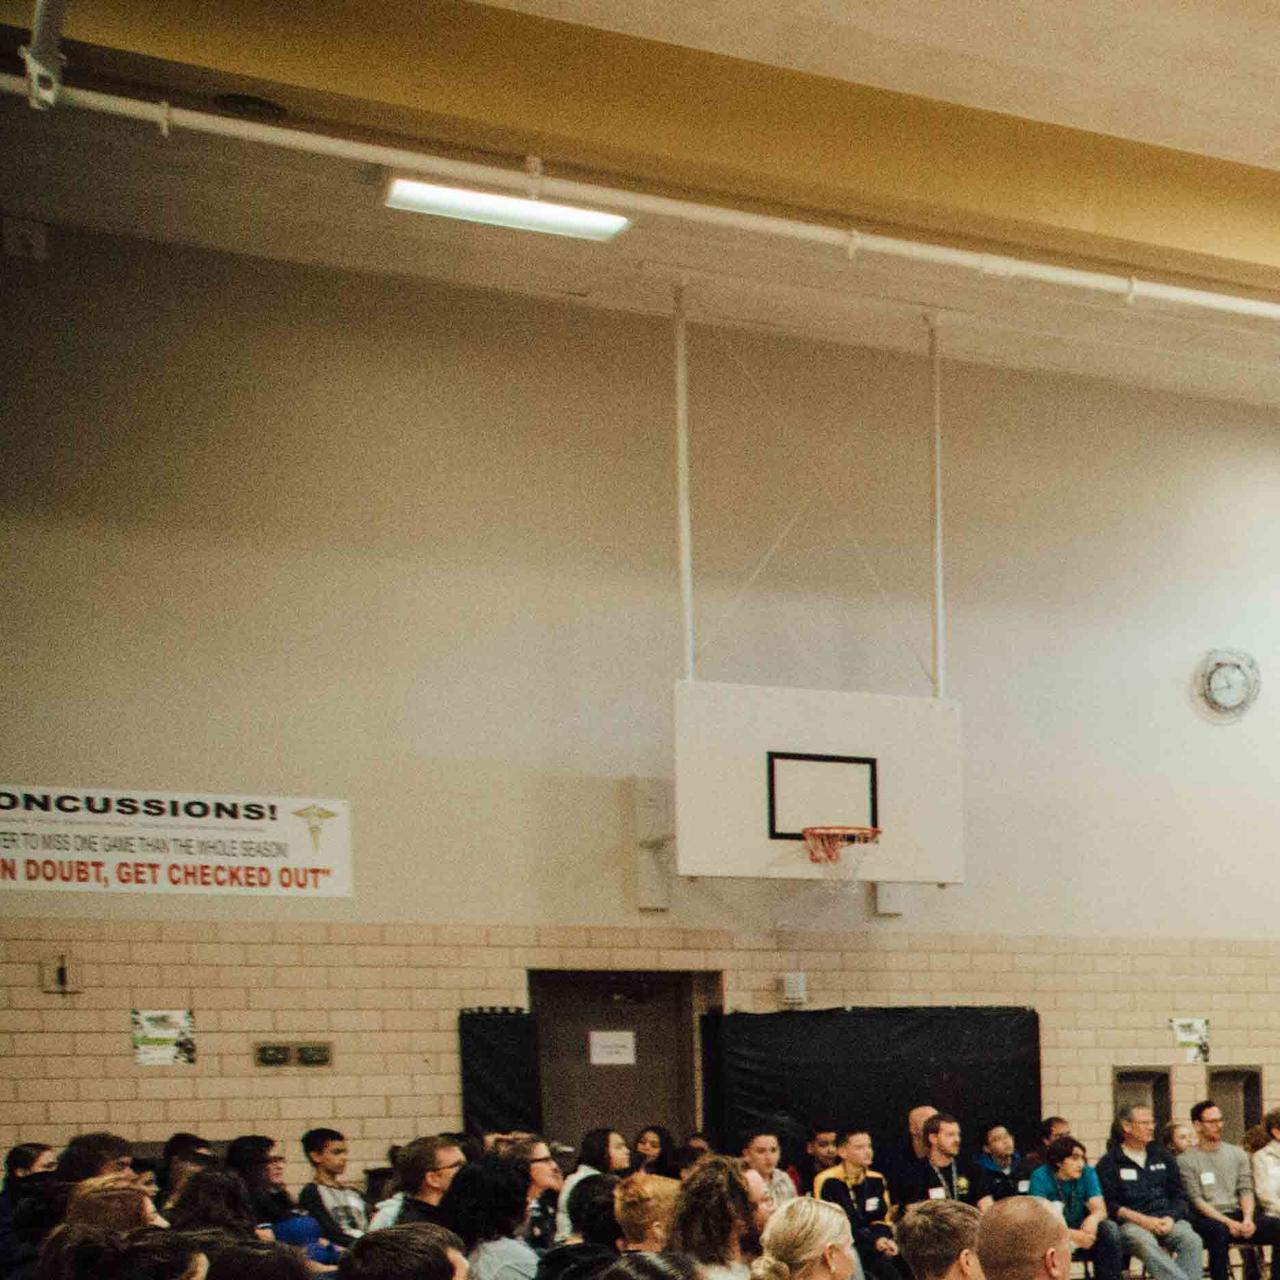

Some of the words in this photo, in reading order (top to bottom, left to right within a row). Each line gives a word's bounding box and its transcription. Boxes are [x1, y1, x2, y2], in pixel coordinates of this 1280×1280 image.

[42, 833, 70, 853] MISS
[73, 834, 98, 853] ONE
[102, 835, 136, 854] GAME
[138, 836, 170, 855] THAN
[172, 837, 195, 856] THE
[199, 838, 238, 858] WHOLE
[25, 859, 109, 888] DOUBT,
[116, 862, 161, 885] GET
[167, 863, 272, 888] CHECKED
